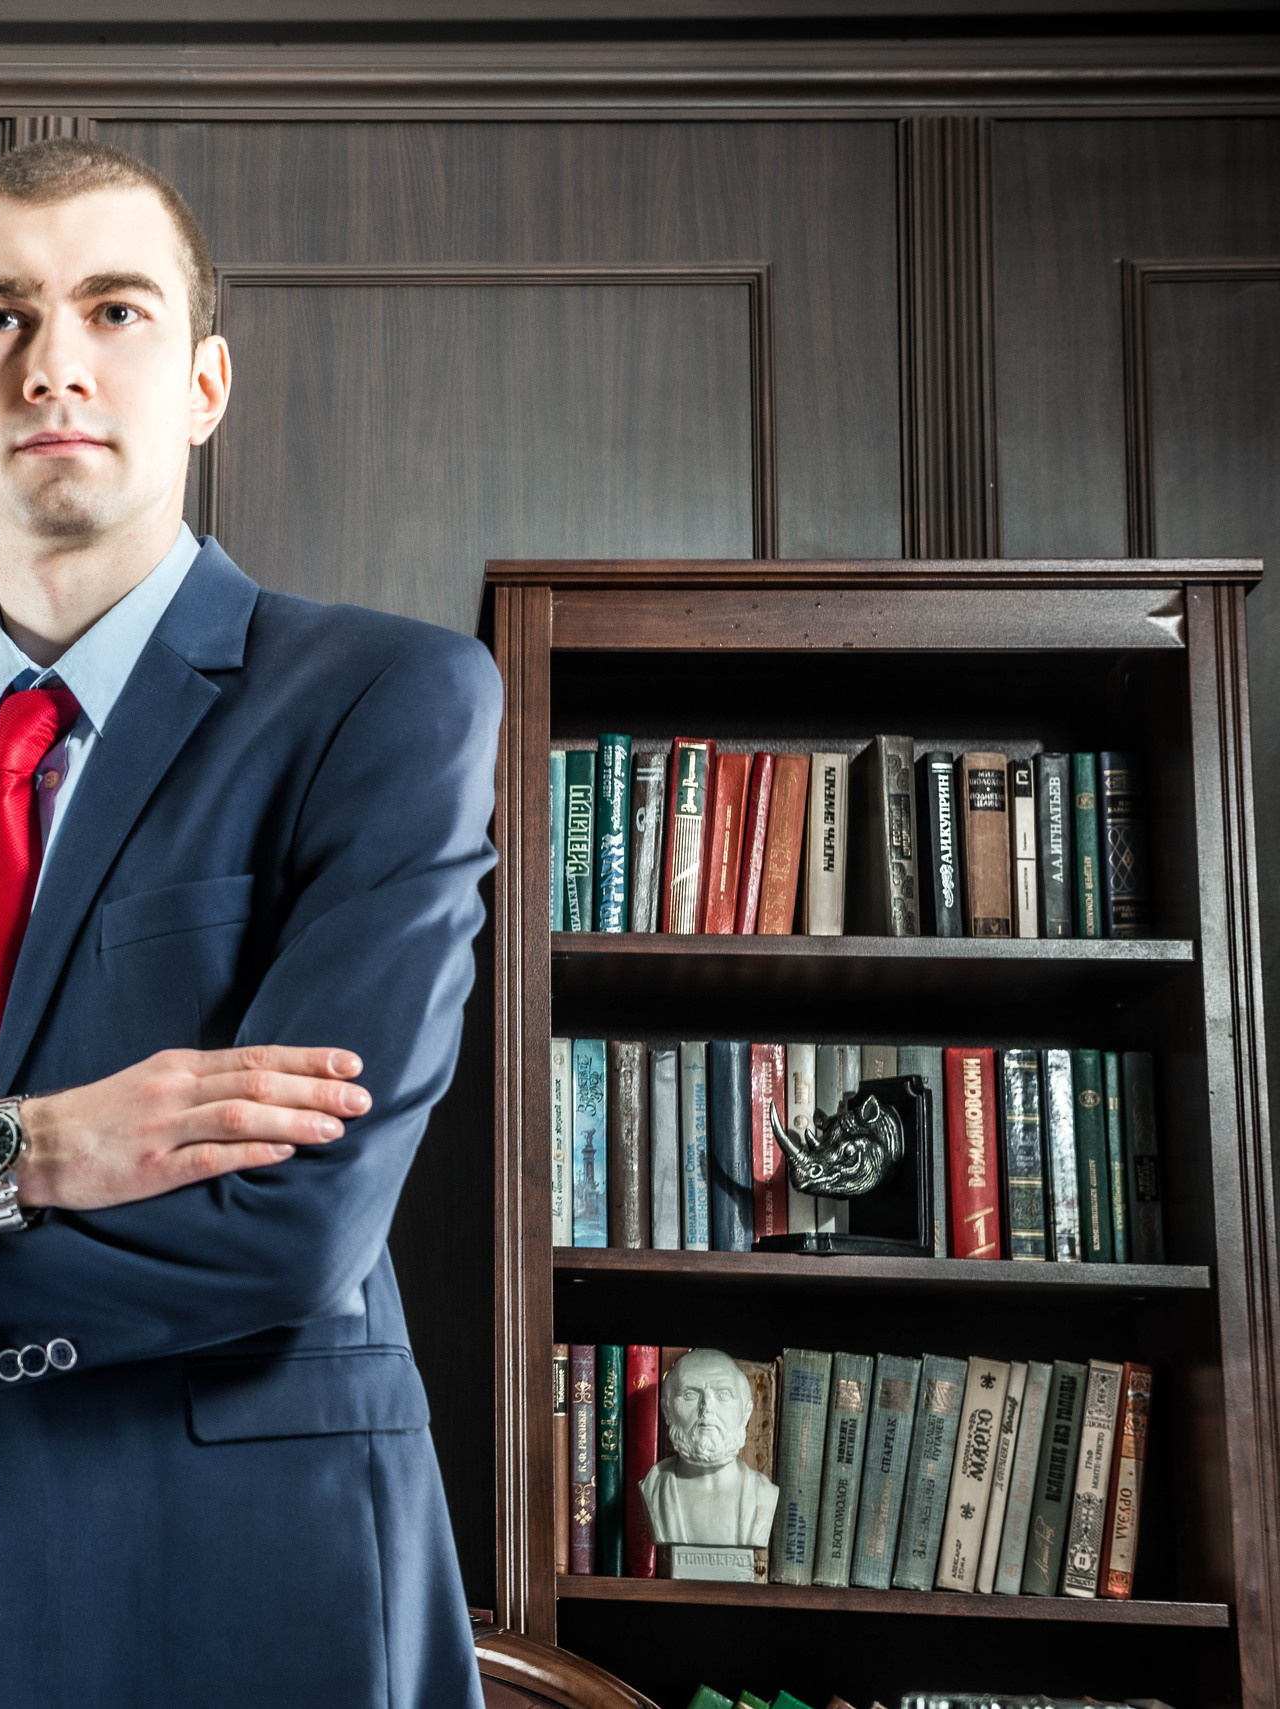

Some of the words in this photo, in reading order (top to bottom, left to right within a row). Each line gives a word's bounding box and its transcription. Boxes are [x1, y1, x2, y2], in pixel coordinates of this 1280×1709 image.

[568, 784, 592, 877] МАСТЕРА
[684, 1143, 695, 1172] Спок
[686, 1177, 696, 1243] Бенджамин
[973, 1216, 986, 1247] 1
[1056, 1375, 1078, 1420] ГОЛОВЫ
[837, 1419, 849, 1463] МОМЕНТ
[845, 1419, 857, 1464] ИСТИНЫ
[881, 1418, 897, 1474] СПАРТАК
[967, 1408, 993, 1482] МАРГО
[1053, 1423, 1070, 1445] БЕЗ
[1046, 1446, 1067, 1502] ВСАДНИК
[1116, 1488, 1132, 1539] ОРУЭЛЛ
